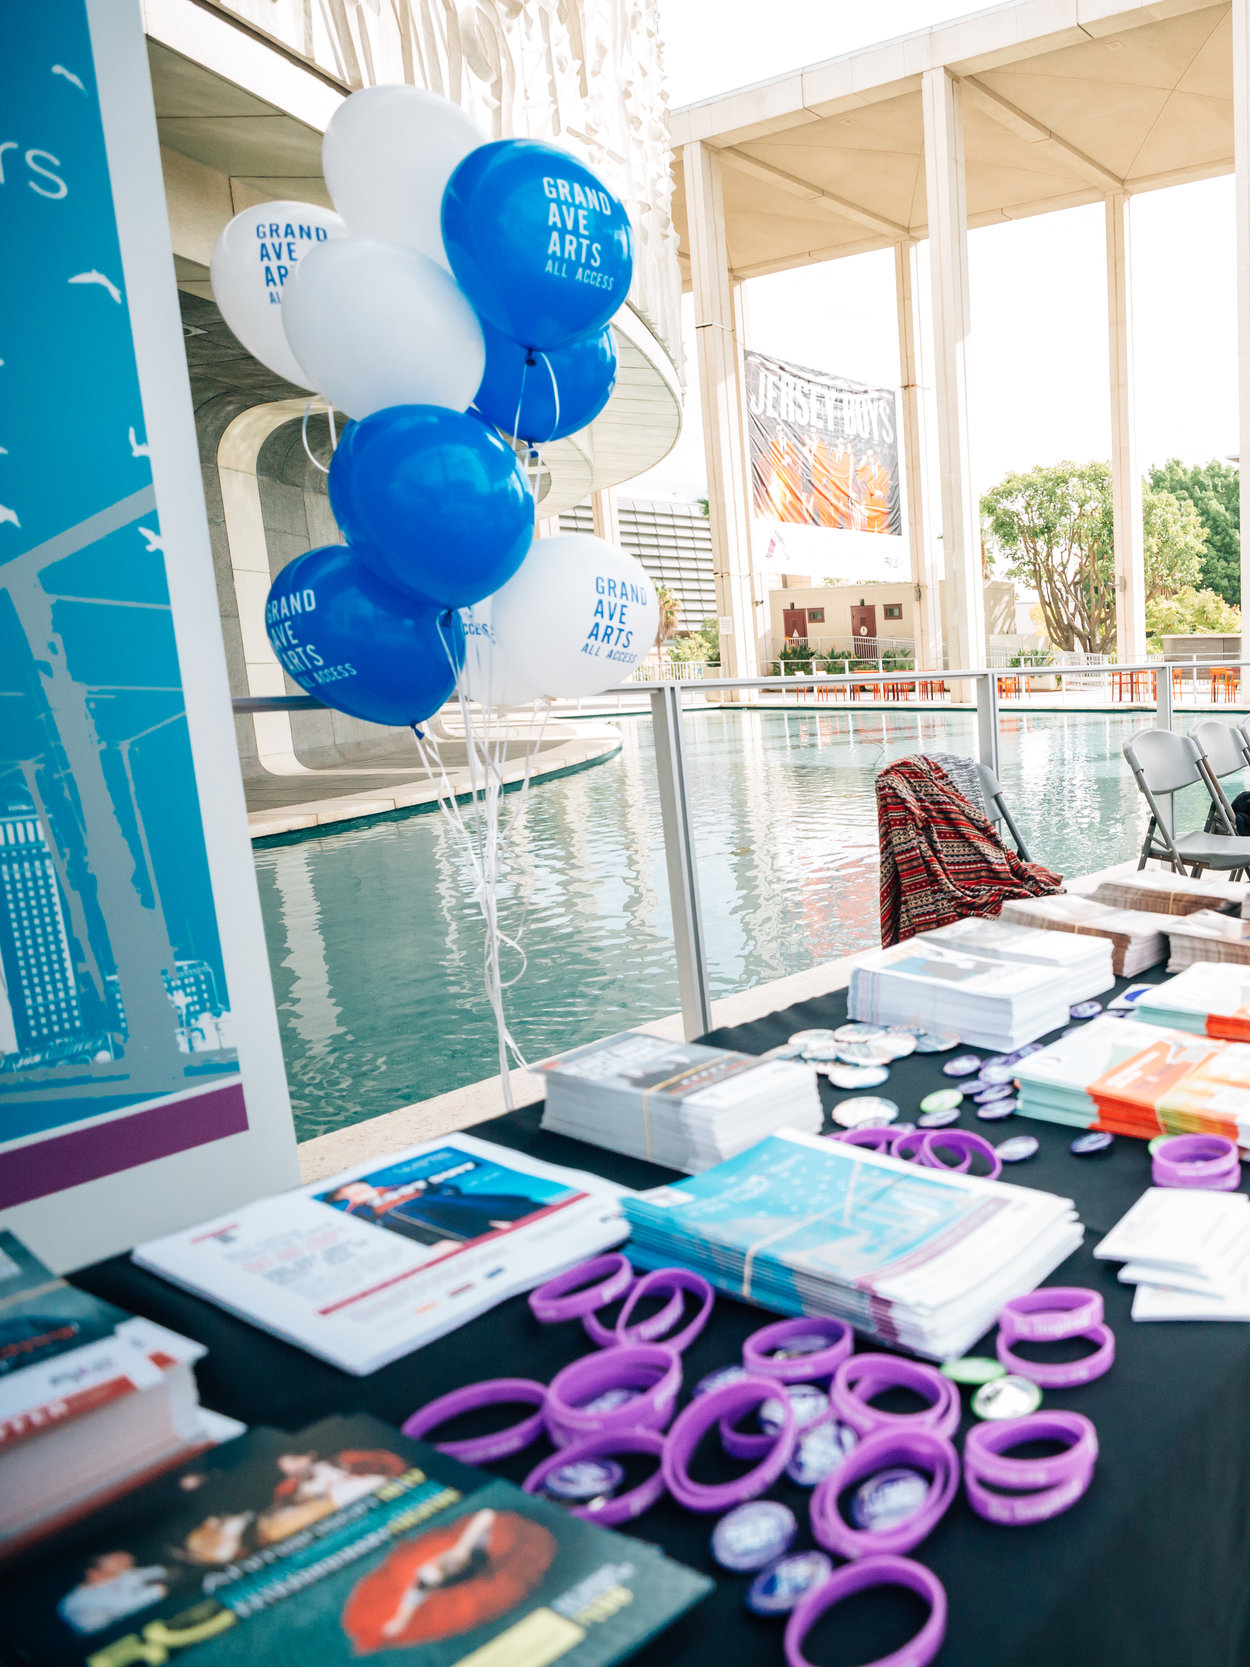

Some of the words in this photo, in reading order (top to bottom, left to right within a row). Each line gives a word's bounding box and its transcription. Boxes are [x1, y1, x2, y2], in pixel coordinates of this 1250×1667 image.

[542, 176, 612, 216] GRAND
[256, 222, 328, 242] GRAND
[547, 201, 590, 236] AVE
[259, 241, 299, 262] AVE
[547, 230, 602, 267] ARTS
[544, 258, 568, 279] ALL
[575, 266, 615, 291] ACCESS
[749, 369, 836, 432] JERSEY
[844, 394, 894, 444] BOYS
[266, 589, 317, 624] GRAND
[595, 576, 648, 606] GRAND
[593, 599, 629, 625] AVE
[587, 622, 634, 649] ARTS
[281, 643, 325, 674] ARTS
[579, 642, 601, 657] ALL
[605, 648, 638, 664] ACCESS
